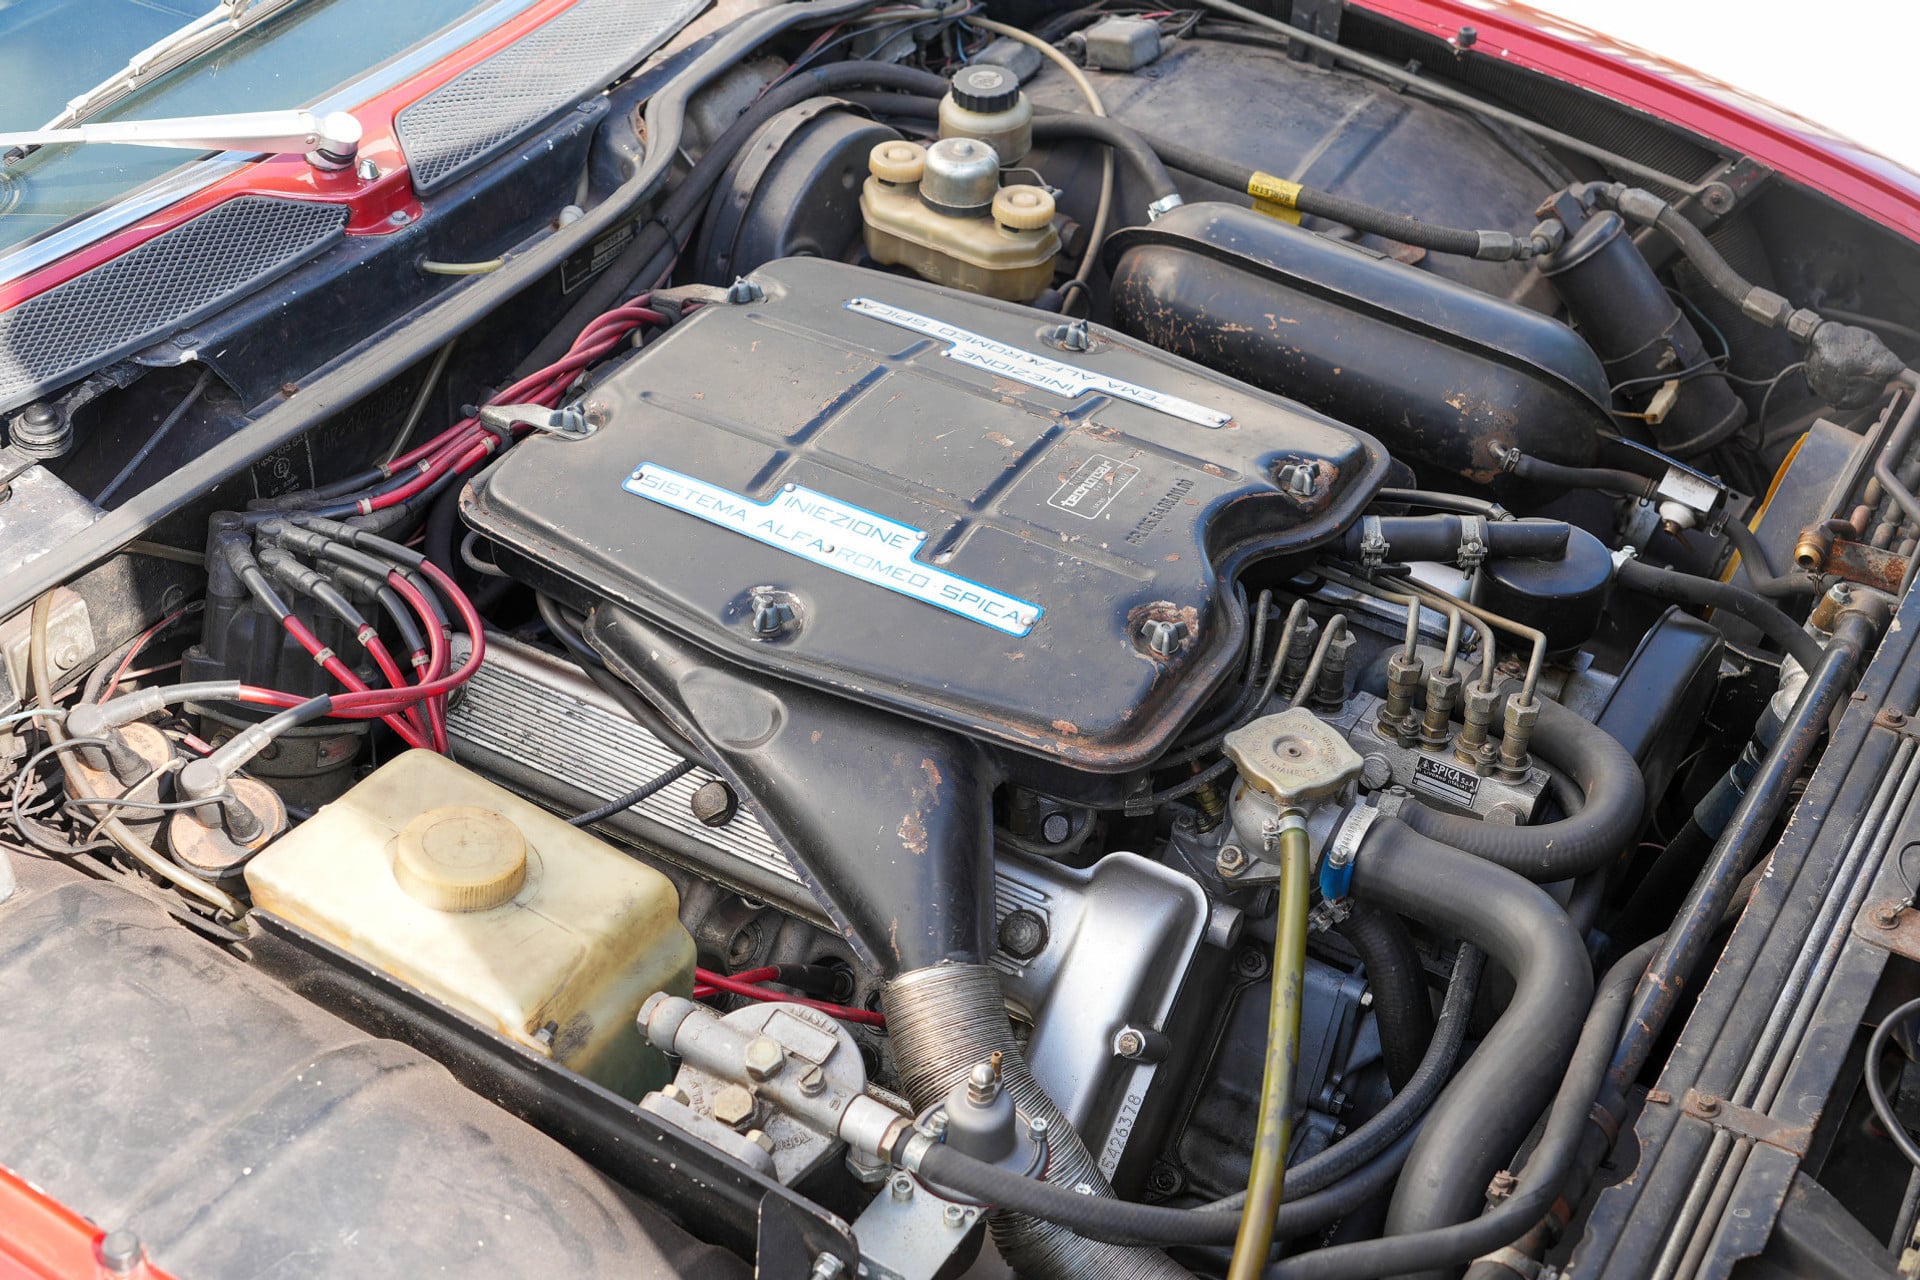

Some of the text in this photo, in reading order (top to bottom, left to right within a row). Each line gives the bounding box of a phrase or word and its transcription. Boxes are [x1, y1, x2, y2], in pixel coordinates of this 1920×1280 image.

[1251, 184, 1291, 202] BORLETTI
[863, 303, 1097, 380] ALFA ROMEO SPICA
[957, 350, 1075, 391] INIEZIONE
[784, 495, 909, 550] INIEZIONE
[640, 474, 1020, 624] SISTEMA ALFA ROMEO SPICA
[1424, 770, 1447, 782] LIVORNO
[1432, 763, 1460, 782] SPICA
